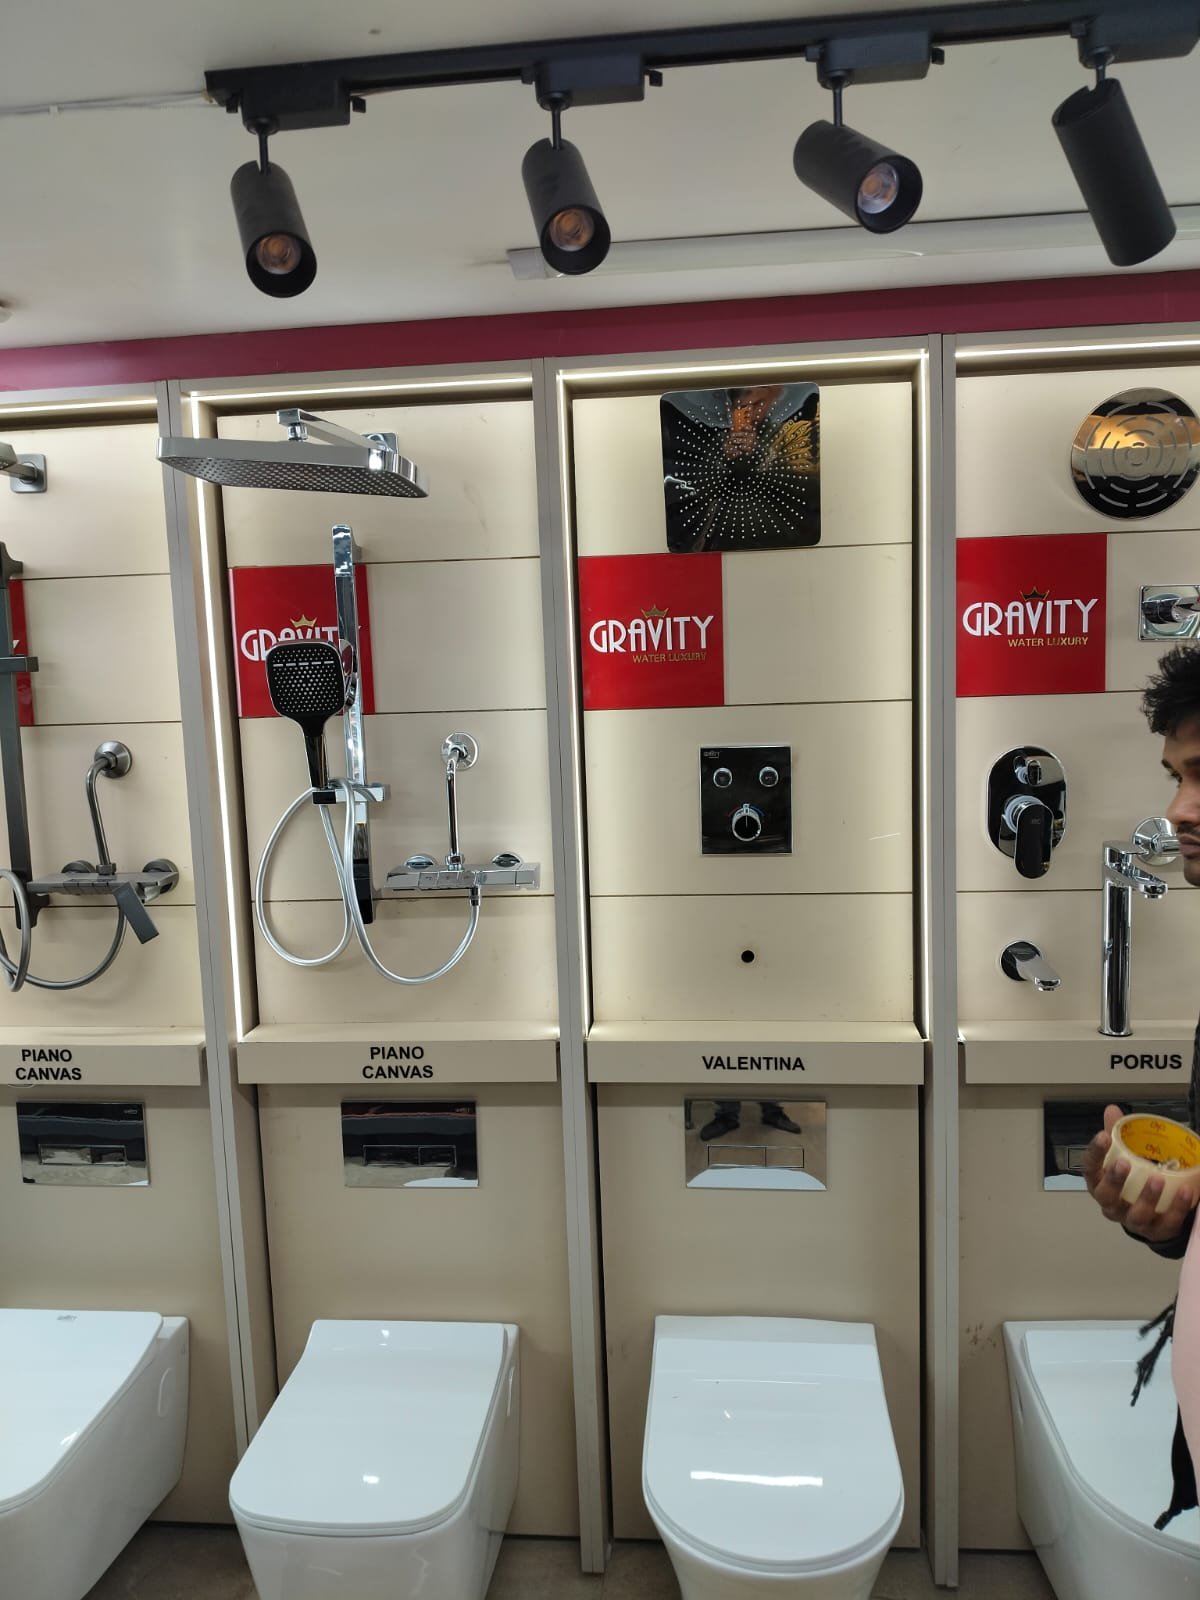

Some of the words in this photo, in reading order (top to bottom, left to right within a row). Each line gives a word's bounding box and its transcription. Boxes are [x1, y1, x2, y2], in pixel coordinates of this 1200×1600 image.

[962, 598, 1099, 637] GRAVITY
[589, 615, 714, 653] GRAVITY
[1008, 638, 1044, 647] WATER
[1047, 636, 1089, 646] LUXURY
[632, 653, 666, 663] WATER
[668, 651, 707, 662] LUXURY
[21, 1049, 72, 1062] PIANO
[370, 1046, 425, 1060] PIANO
[702, 1055, 806, 1071] VALENTINA
[1110, 1053, 1183, 1070] PORUS
[15, 1067, 82, 1081] CANVAS
[362, 1064, 434, 1080] CANVAS
